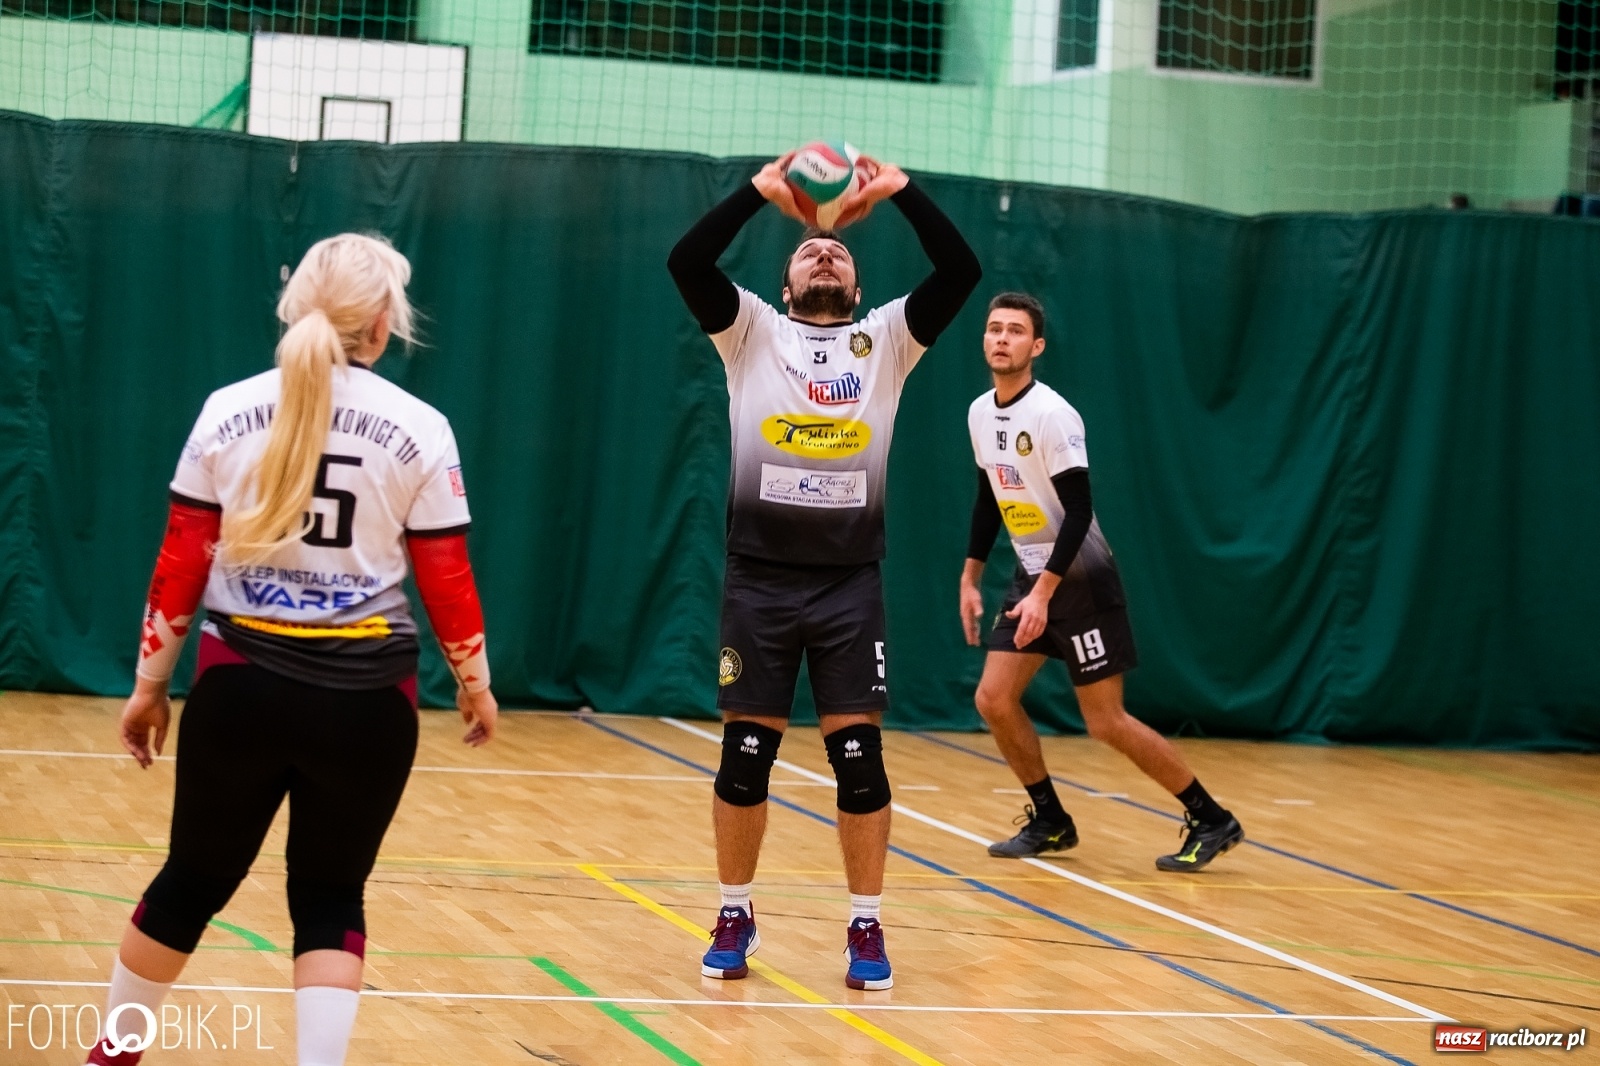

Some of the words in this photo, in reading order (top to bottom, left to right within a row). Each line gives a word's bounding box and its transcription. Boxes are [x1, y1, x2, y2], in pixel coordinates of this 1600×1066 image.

[996, 430, 1007, 451] 19
[301, 453, 363, 549] 5
[874, 641, 885, 679] 5
[1071, 628, 1106, 664] 19
